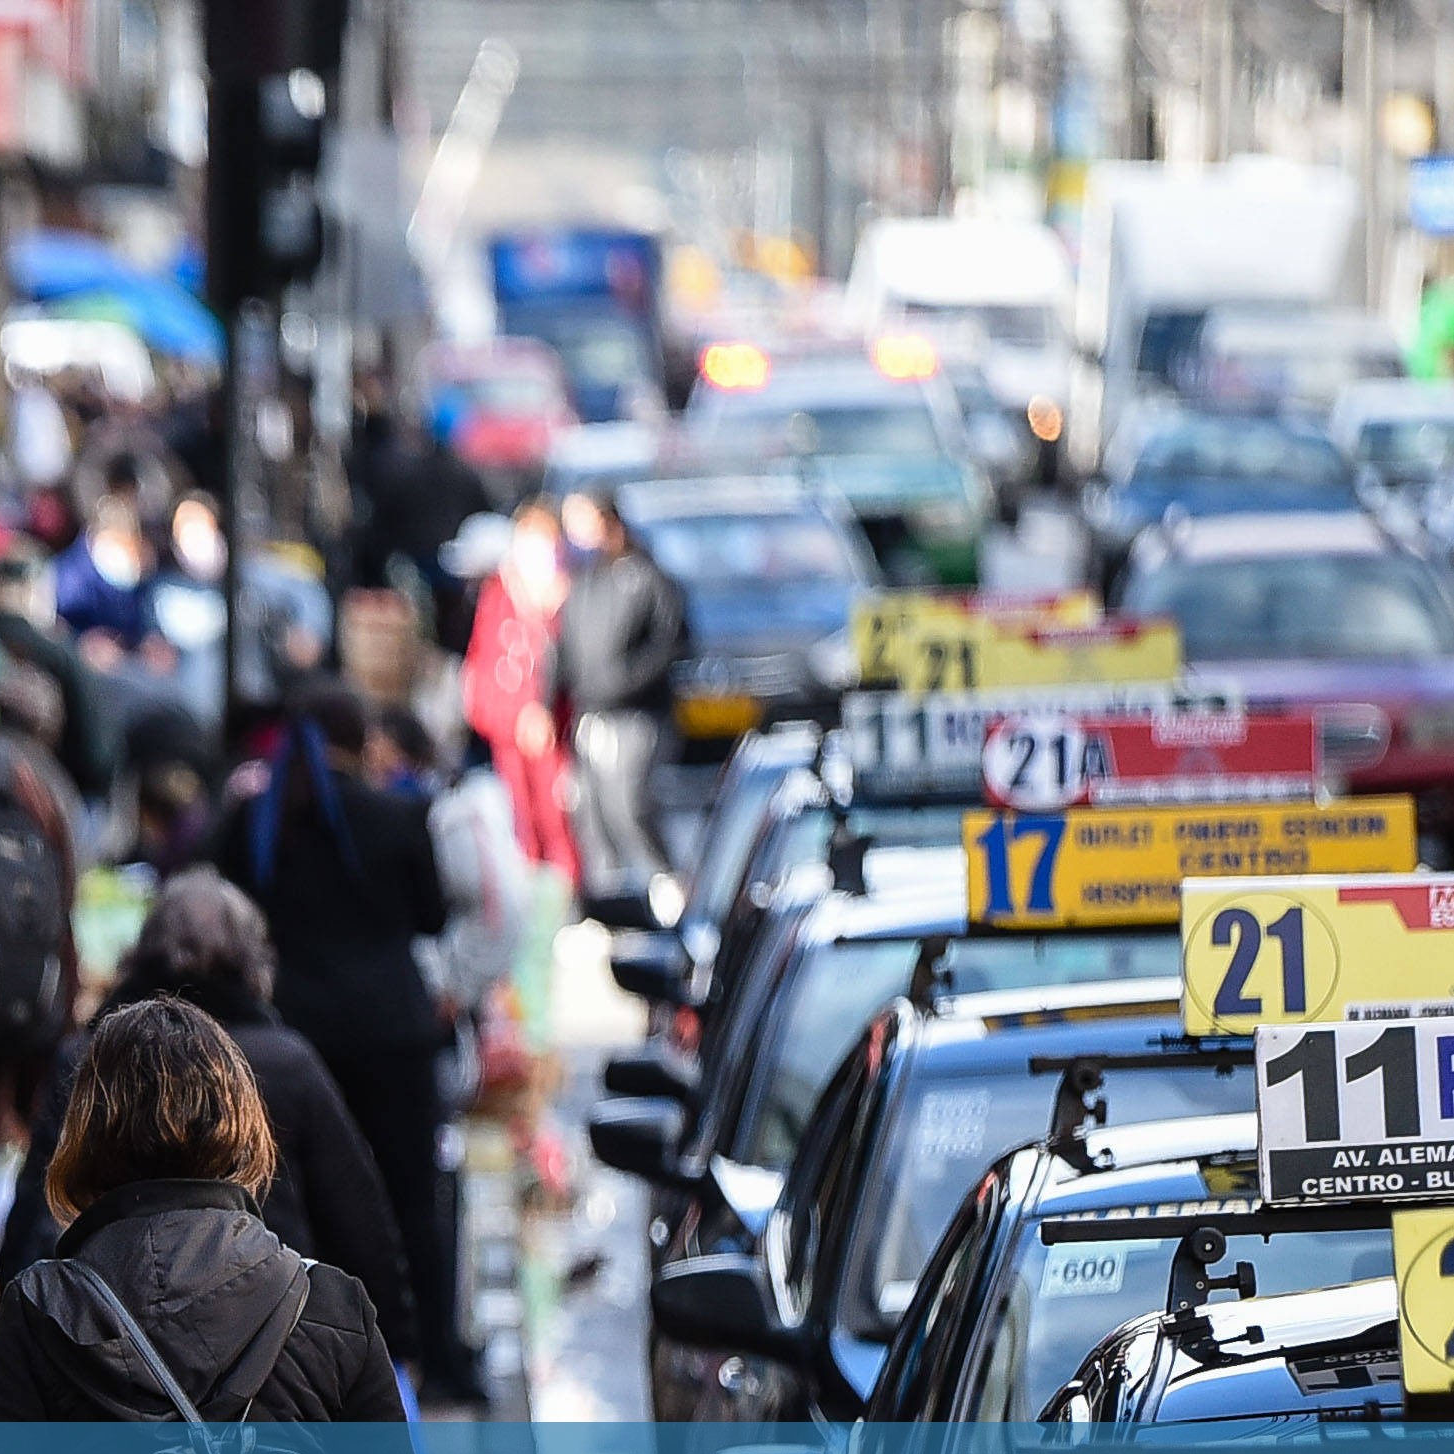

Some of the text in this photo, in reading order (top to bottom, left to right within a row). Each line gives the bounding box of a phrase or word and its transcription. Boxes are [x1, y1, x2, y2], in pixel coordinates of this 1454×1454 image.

[976, 812, 1067, 915] 17
[1211, 907, 1306, 1015] 21
[1265, 1025, 1422, 1143] 11
[1301, 1173, 1404, 1195] CENTRO
[1333, 1150, 1371, 1169] AV.
